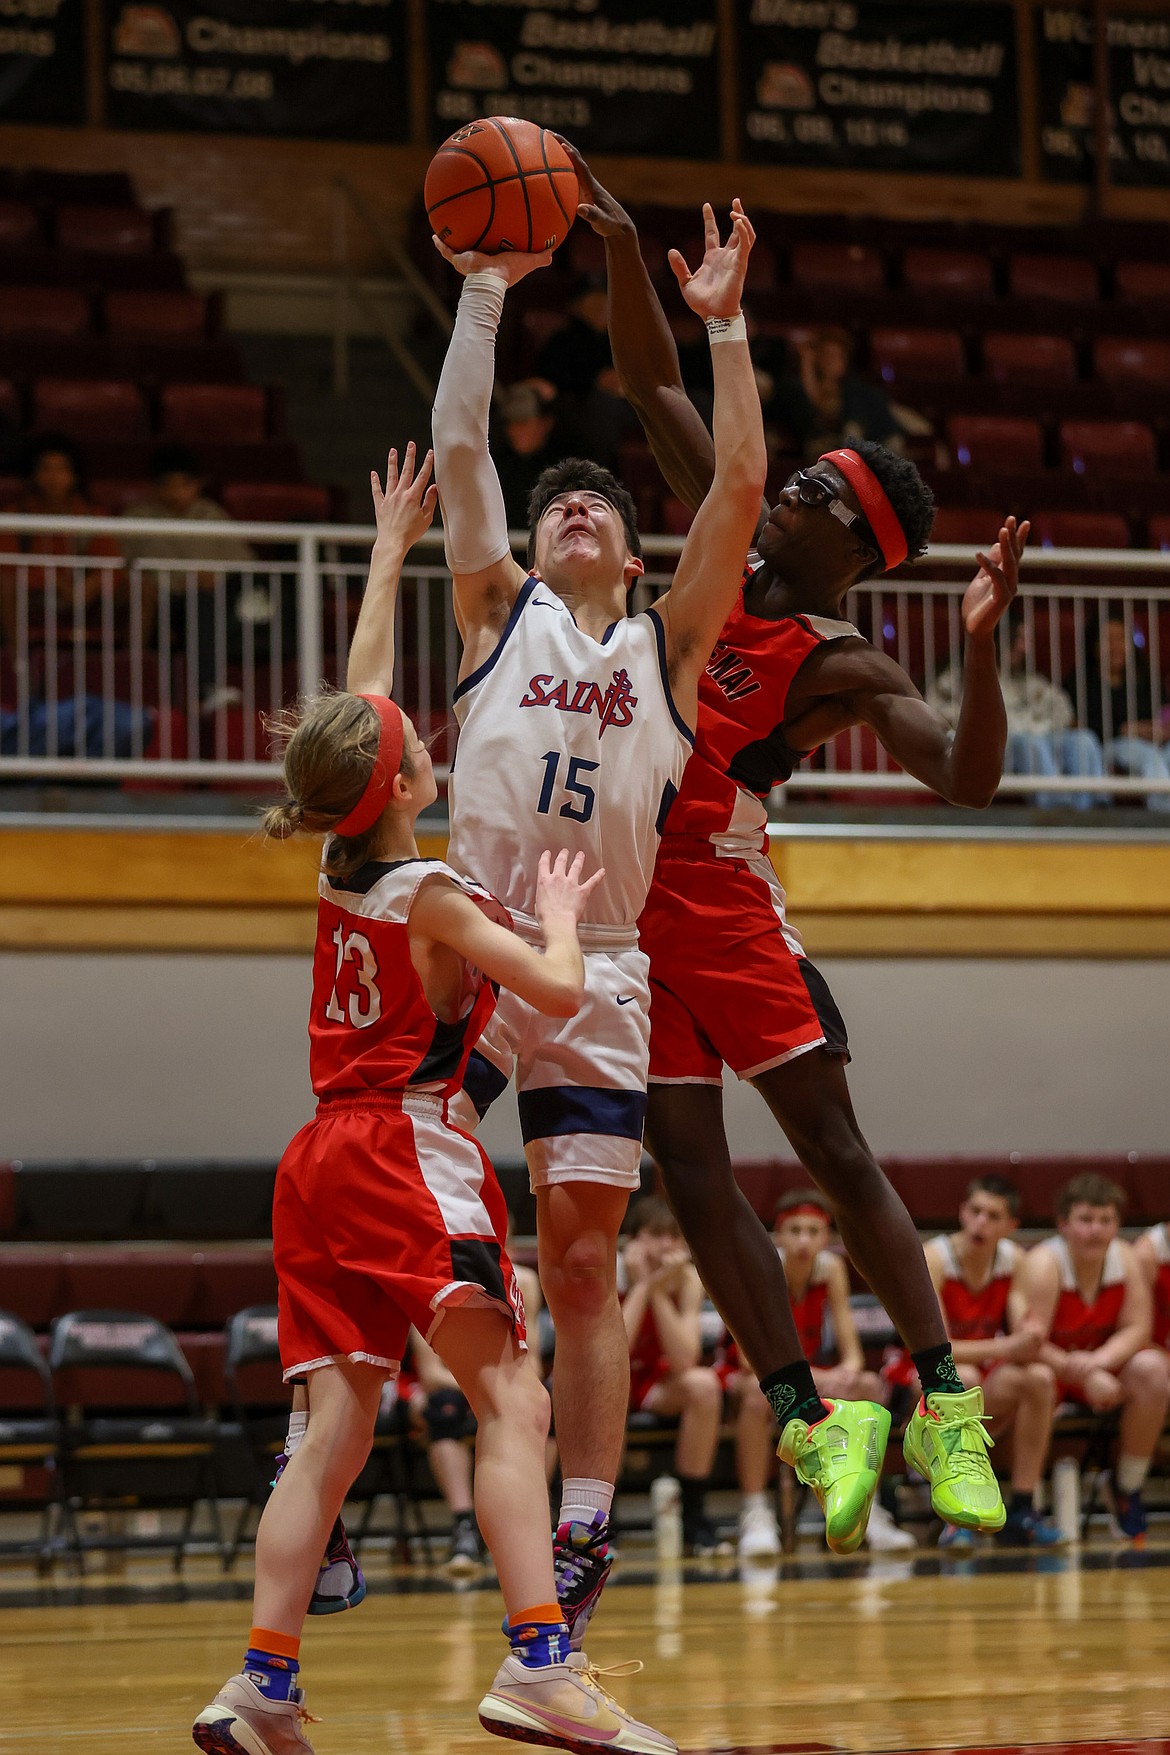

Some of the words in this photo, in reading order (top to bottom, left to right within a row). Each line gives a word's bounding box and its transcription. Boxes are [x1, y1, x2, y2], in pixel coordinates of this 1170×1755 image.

[187, 16, 391, 65] Champions
[520, 12, 717, 57] Basketball
[816, 32, 1003, 77] Basketball
[511, 52, 692, 96] Champions
[819, 73, 993, 117] Champions
[519, 669, 638, 740] SAINTS
[537, 750, 600, 824] 15
[325, 919, 382, 1030] 13
